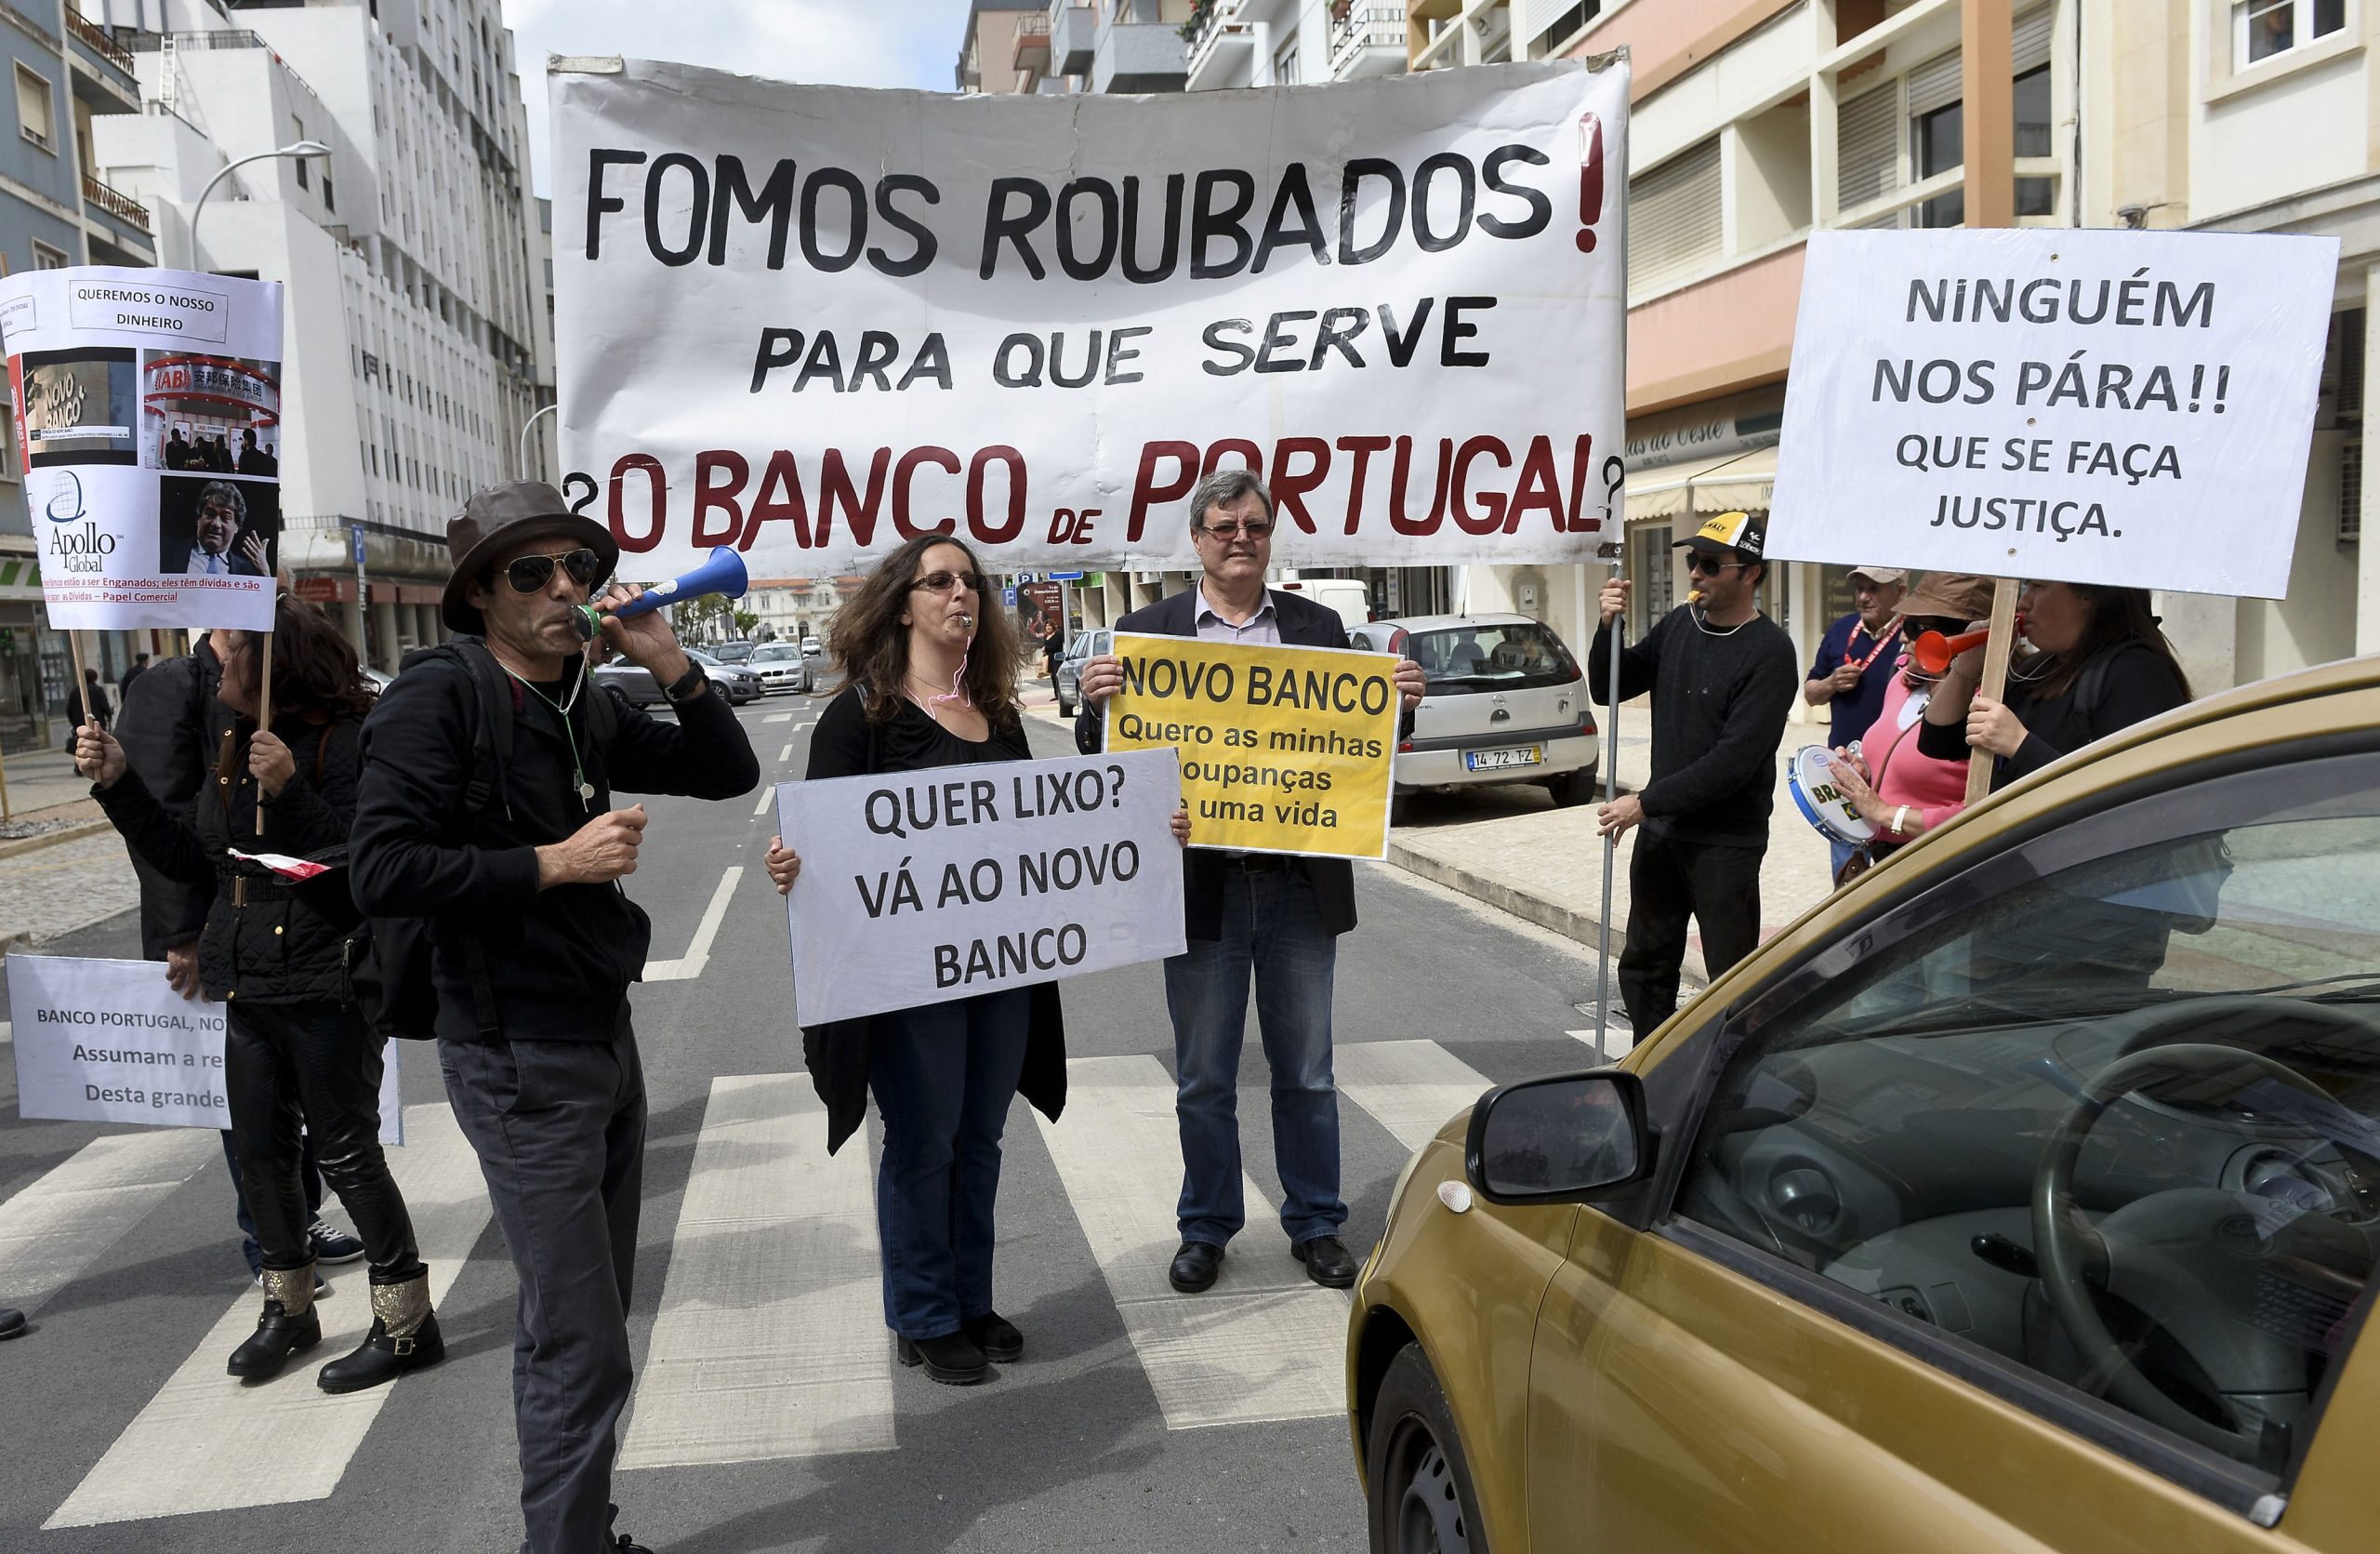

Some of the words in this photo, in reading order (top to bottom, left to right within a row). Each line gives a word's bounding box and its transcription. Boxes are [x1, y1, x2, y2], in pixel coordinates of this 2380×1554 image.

[585, 148, 941, 277] FOMOS
[77, 288, 151, 304] QUEREMOS
[154, 292, 165, 305] O
[169, 295, 215, 312] NOSSO
[1906, 267, 2215, 327] NINGUÉM
[116, 313, 183, 330] DINHEIRO
[749, 326, 952, 393] PARA
[992, 325, 1152, 388] QUE
[1201, 297, 1498, 377] SERVE
[46, 372, 74, 410] NOVO
[193, 369, 262, 397] 安邦保险集团
[1871, 358, 1996, 405] NOS
[2016, 349, 2231, 414] PÁRA!!
[46, 397, 82, 429] BANCO
[1896, 434, 1990, 473] QUE
[2001, 438, 2053, 472] SE
[2068, 441, 2182, 486] FAÇA
[691, 445, 1027, 552] BANCO
[1047, 508, 1102, 545] DE
[1930, 495, 2122, 543] JUSTIÇA.
[49, 522, 115, 568] Apollo
[69, 555, 103, 572] Global
[87, 578, 99, 587] ser
[102, 578, 160, 589] Enganados;
[162, 578, 178, 588] eles
[180, 578, 197, 588] têm
[199, 578, 231, 589] dívidas
[243, 579, 260, 590] são
[102, 592, 131, 603] Papel
[134, 592, 178, 602] Comercial
[1120, 656, 1235, 703] NOVO
[1247, 664, 1389, 716] BANCO
[1118, 713, 1213, 745] Quero
[1223, 727, 1258, 747] as
[1269, 728, 1383, 760] minhas
[1179, 761, 1332, 792] oupanças
[865, 779, 999, 839] QUER
[1013, 764, 1126, 819] LIXO?
[1199, 801, 1263, 823] uma
[1275, 802, 1339, 829] vida
[854, 856, 924, 919] VÁ
[937, 857, 1004, 909] AO
[1019, 840, 1140, 897] NOVO
[934, 922, 1088, 989] BANCO
[36, 1008, 96, 1026] BANCO
[100, 1012, 194, 1032] PORTUGAL,
[73, 1043, 177, 1067] Assumam
[183, 1052, 195, 1067] a
[86, 1084, 145, 1104] Desta
[152, 1089, 225, 1109] grande
